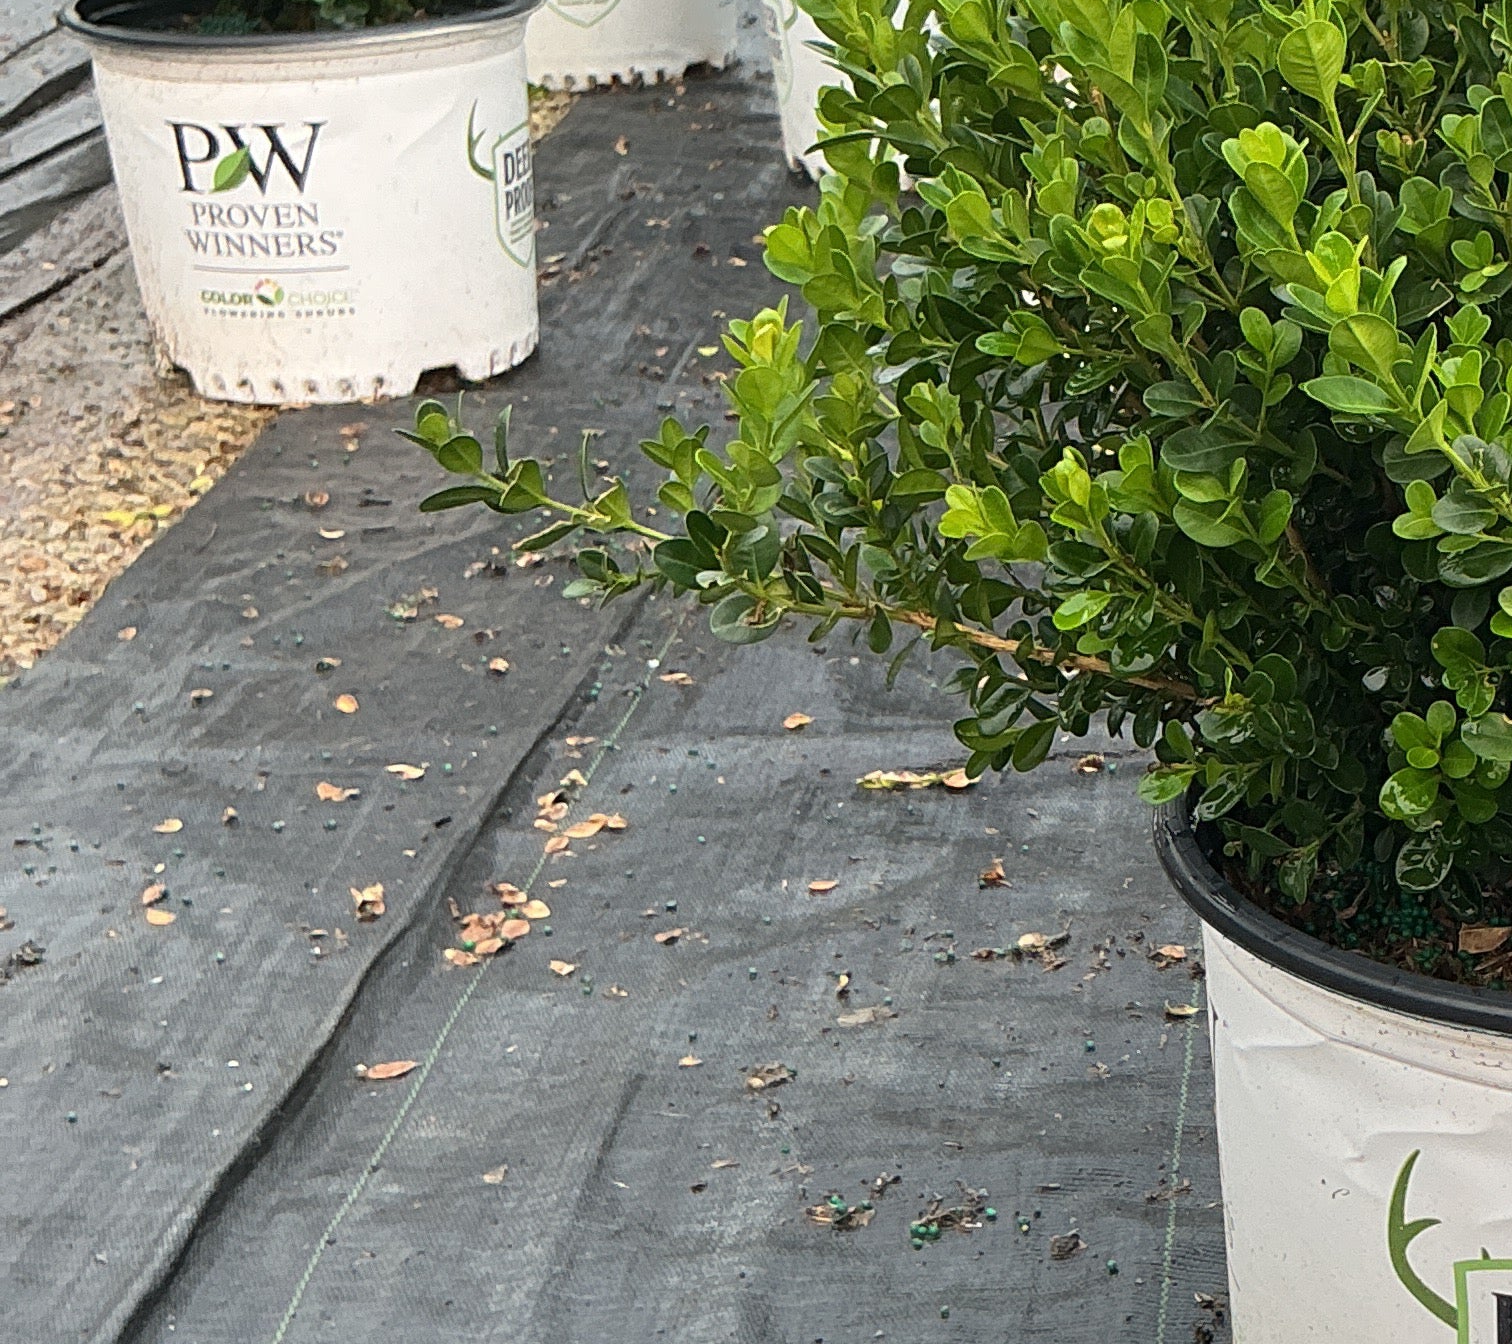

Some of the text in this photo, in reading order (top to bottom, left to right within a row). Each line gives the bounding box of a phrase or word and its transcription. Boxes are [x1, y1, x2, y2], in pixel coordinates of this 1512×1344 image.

[165, 119, 328, 195] PW
[503, 139, 532, 185] DEE
[188, 201, 319, 229] PROVEN
[184, 228, 340, 257] WINNERS
[201, 289, 253, 306] COLOR
